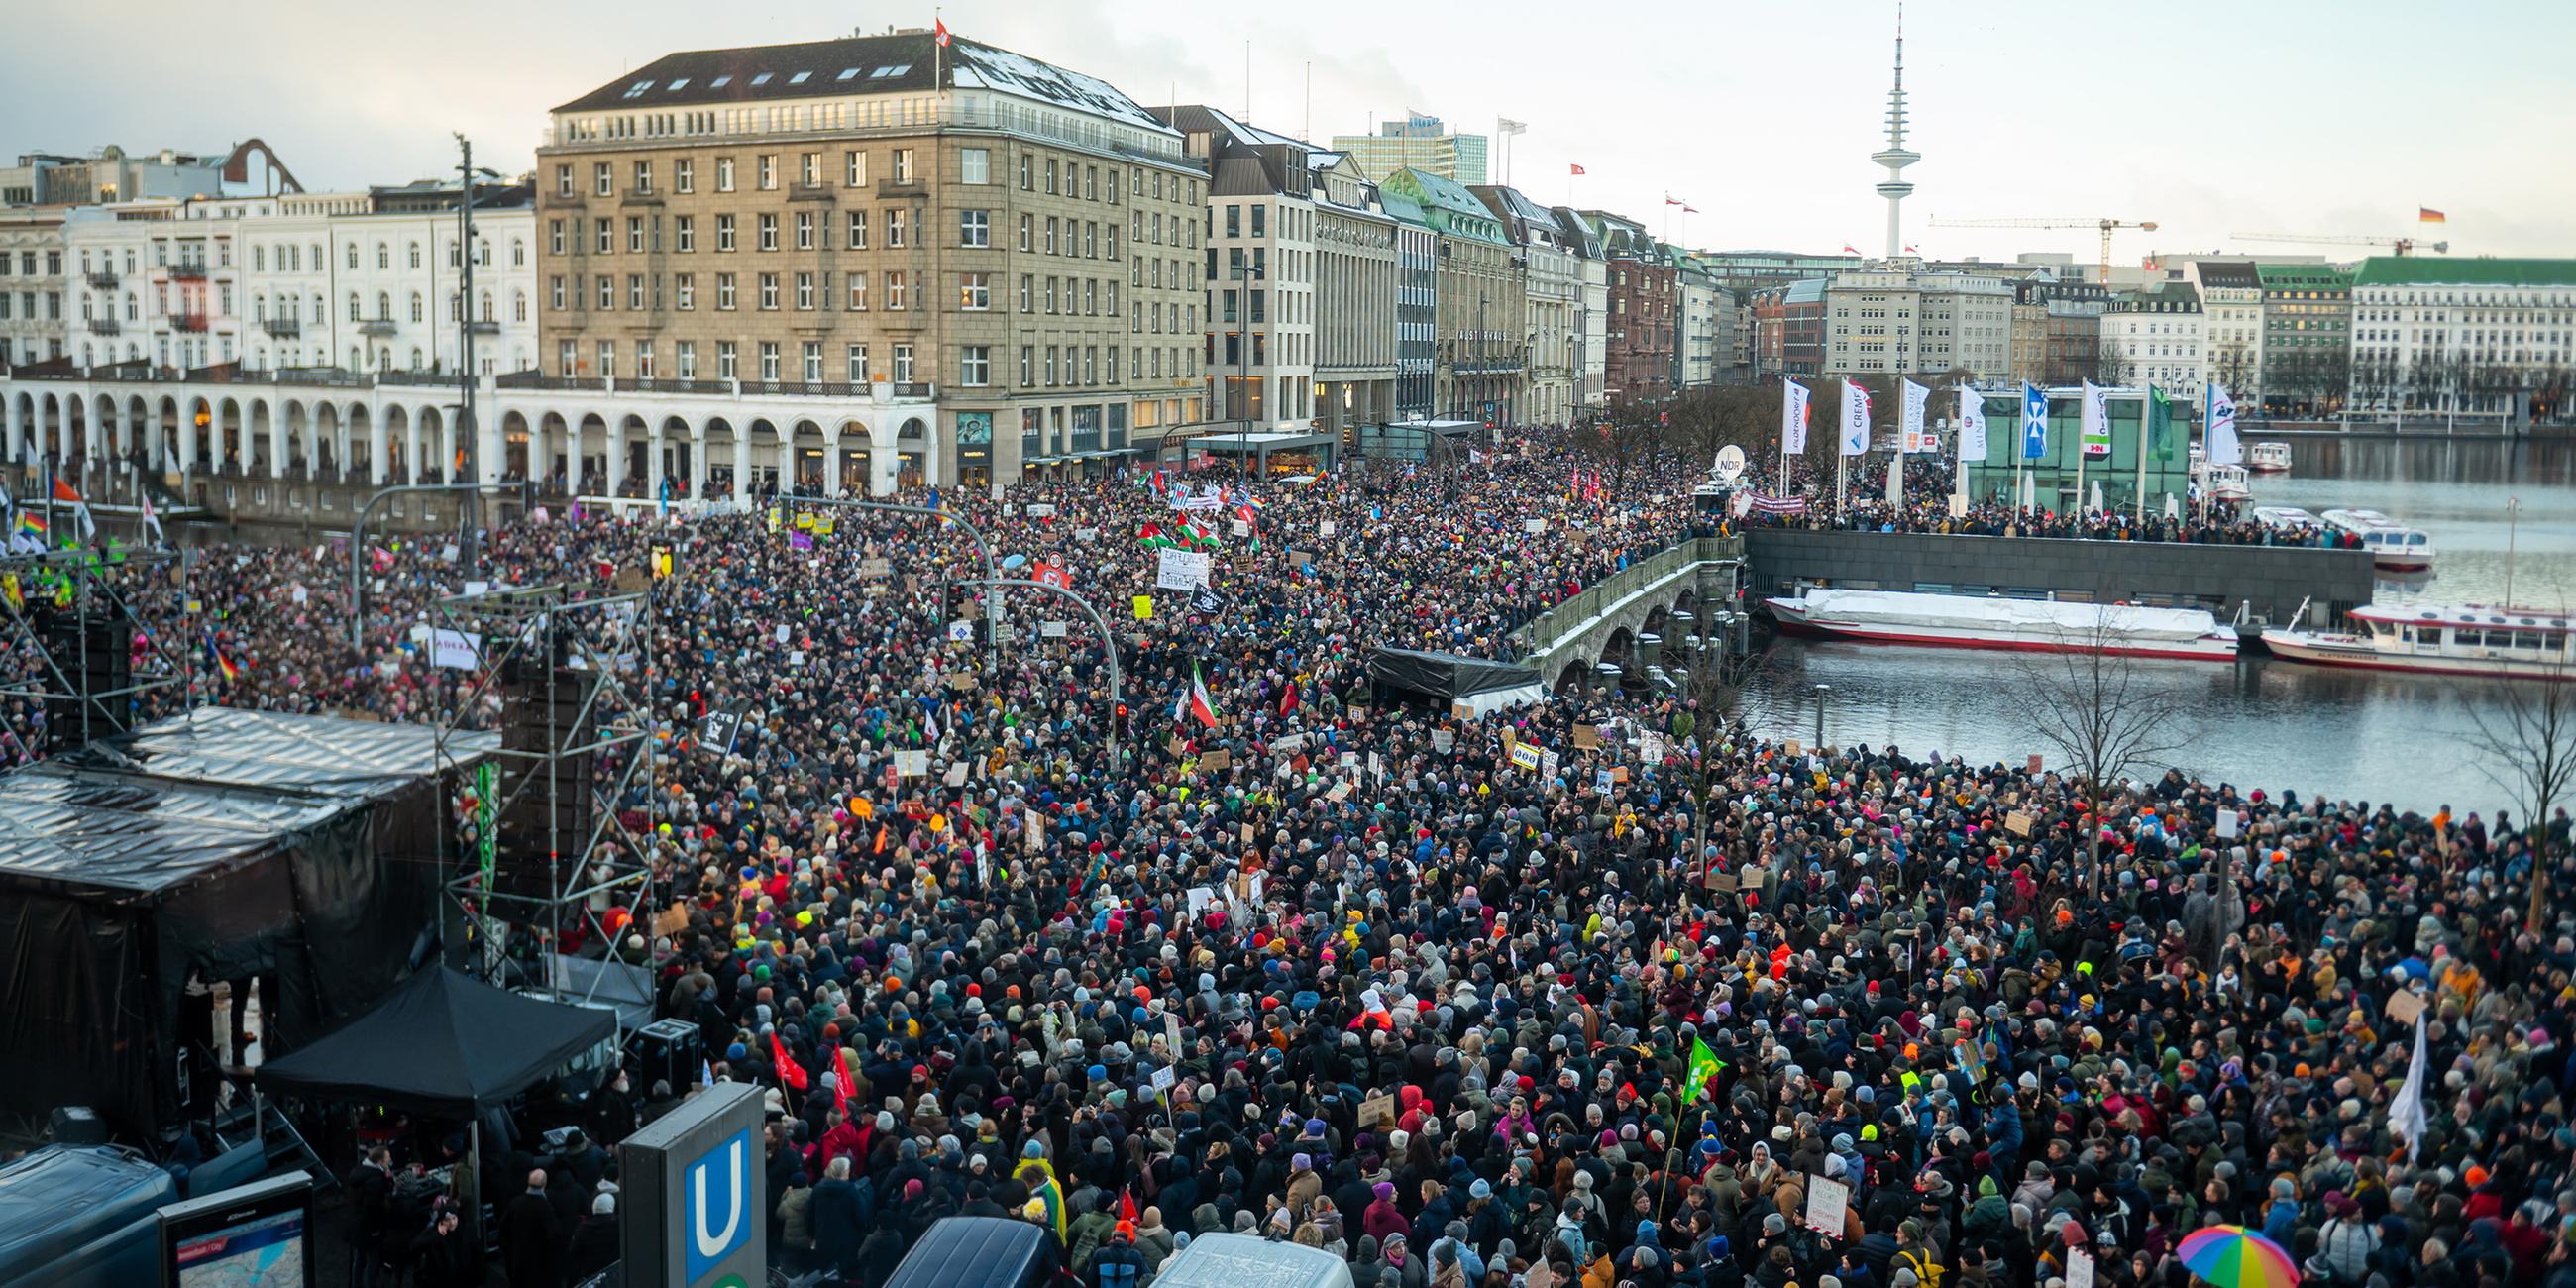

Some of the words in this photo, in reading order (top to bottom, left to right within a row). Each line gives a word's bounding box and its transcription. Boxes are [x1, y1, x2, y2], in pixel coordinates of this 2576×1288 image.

[1458, 330, 1506, 341] ALSTRHAUS
[1486, 403, 1493, 412] U
[1720, 460, 1740, 471] NDR
[1051, 556, 1060, 566] 30
[695, 1139, 742, 1257] U
